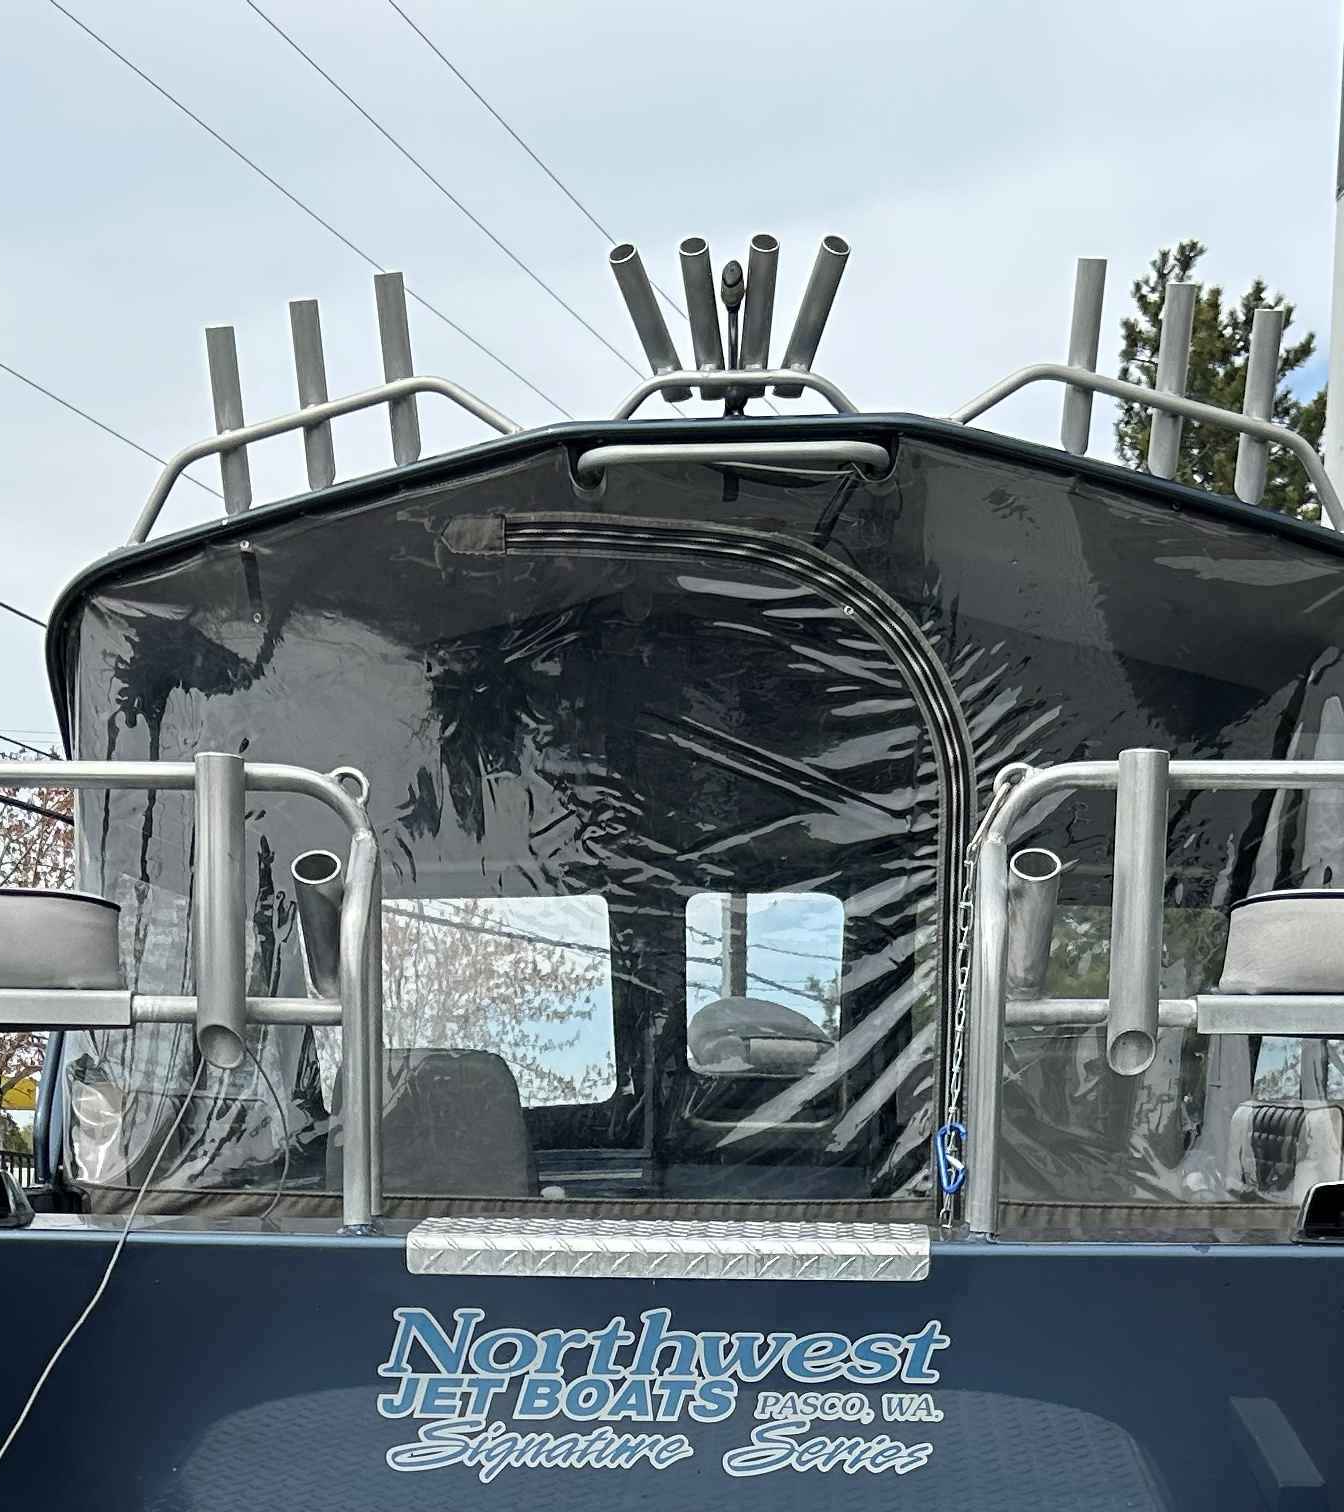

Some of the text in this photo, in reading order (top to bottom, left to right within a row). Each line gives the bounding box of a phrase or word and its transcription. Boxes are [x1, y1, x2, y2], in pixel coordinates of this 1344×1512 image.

[378, 1306, 950, 1385] Northwest
[377, 1373, 945, 1426] JET BOATS PASCO, WA.
[385, 1417, 934, 1484] Signature Series
